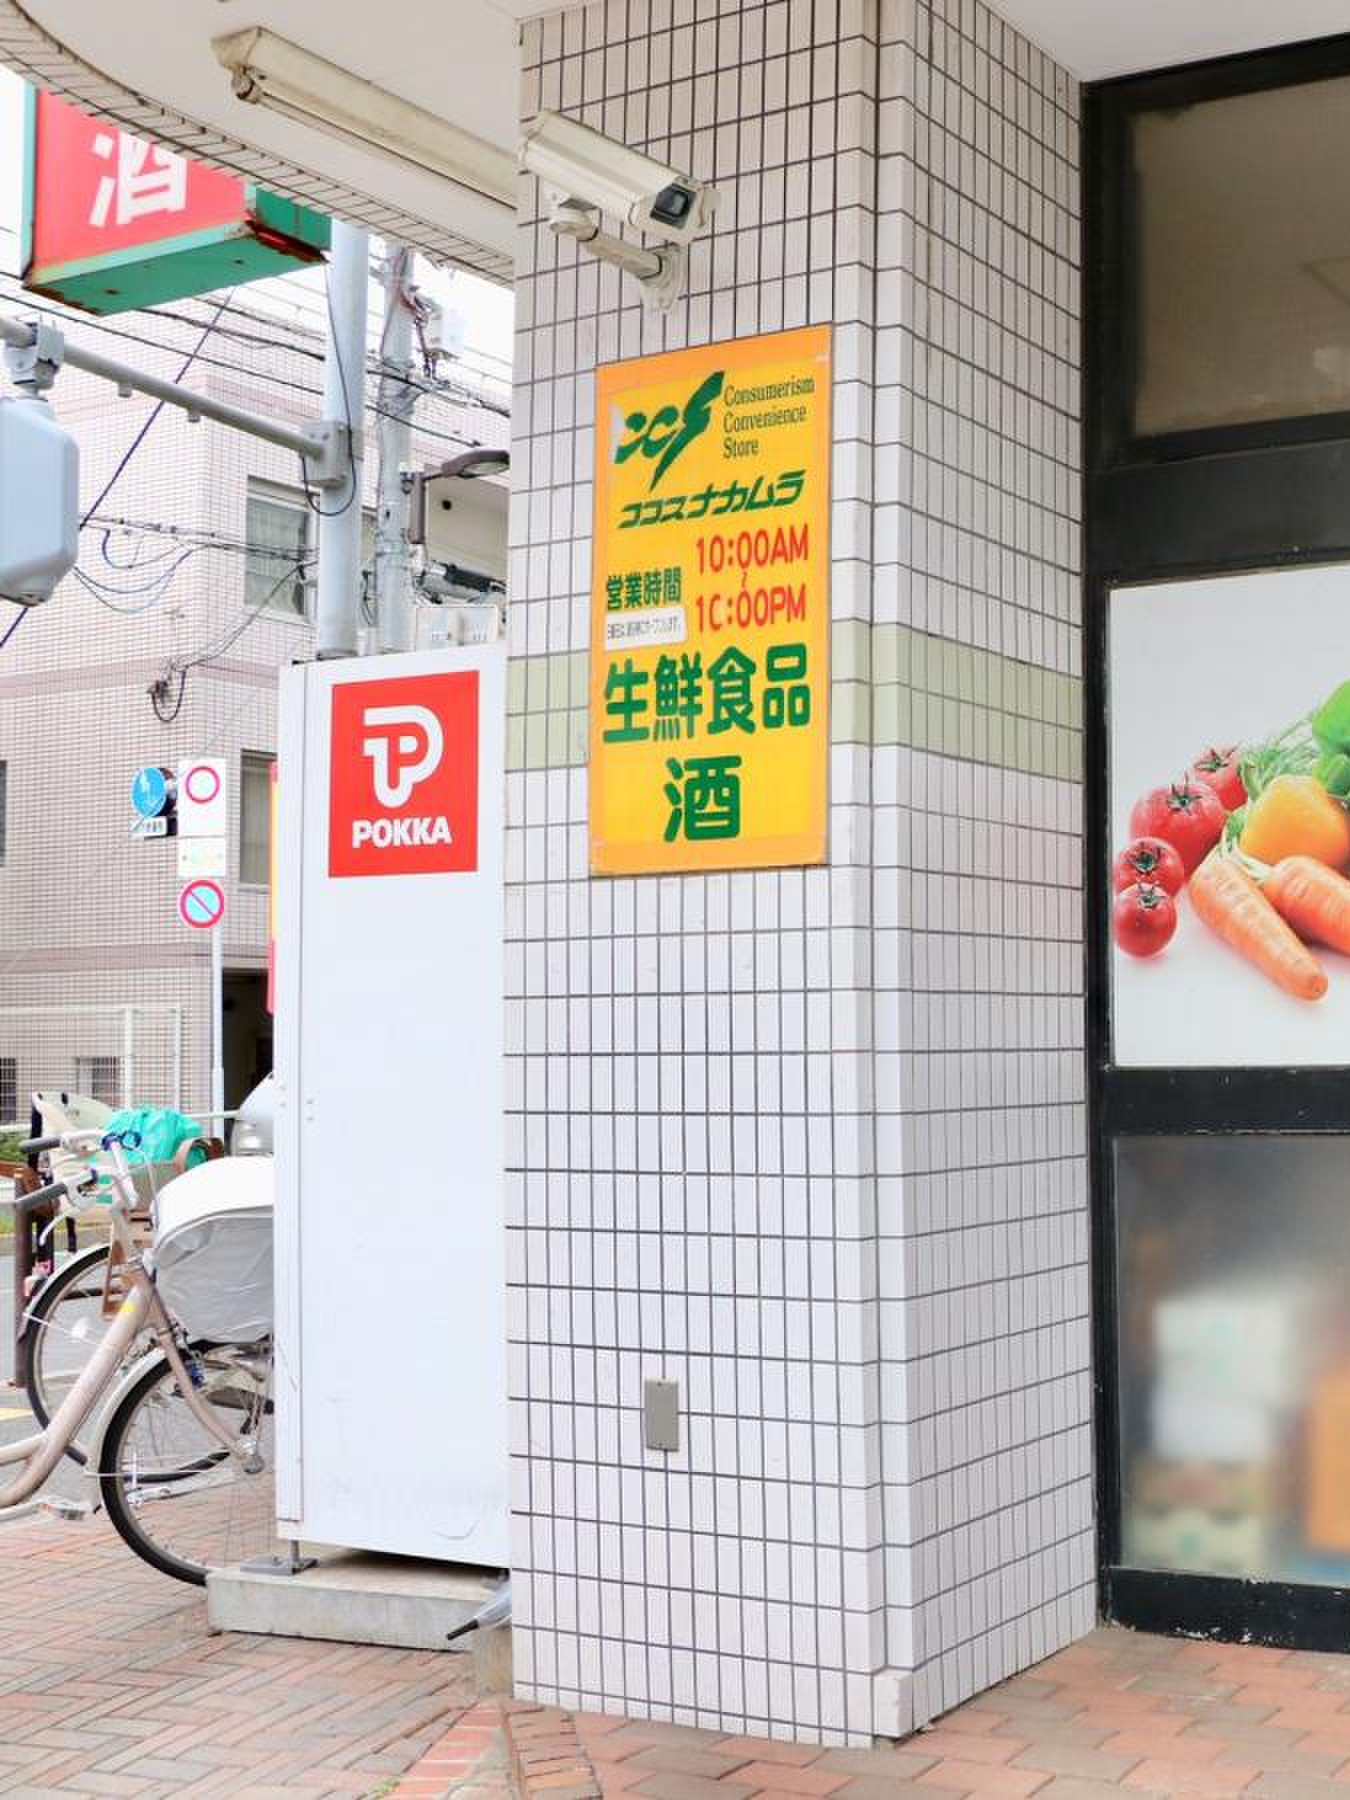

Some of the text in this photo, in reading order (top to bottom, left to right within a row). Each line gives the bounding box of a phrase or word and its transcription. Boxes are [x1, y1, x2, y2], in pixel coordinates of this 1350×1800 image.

[724, 375, 816, 406] Consumerism
[723, 405, 807, 434] Convenience
[723, 437, 759, 460] Store
[618, 469, 807, 529] ココスナカムラ
[696, 523, 808, 576] 10:00AM
[606, 567, 681, 611] 営業時間
[603, 642, 811, 744] 生鮮食品
[664, 755, 742, 842] 酒
[352, 816, 452, 848] POKKA
